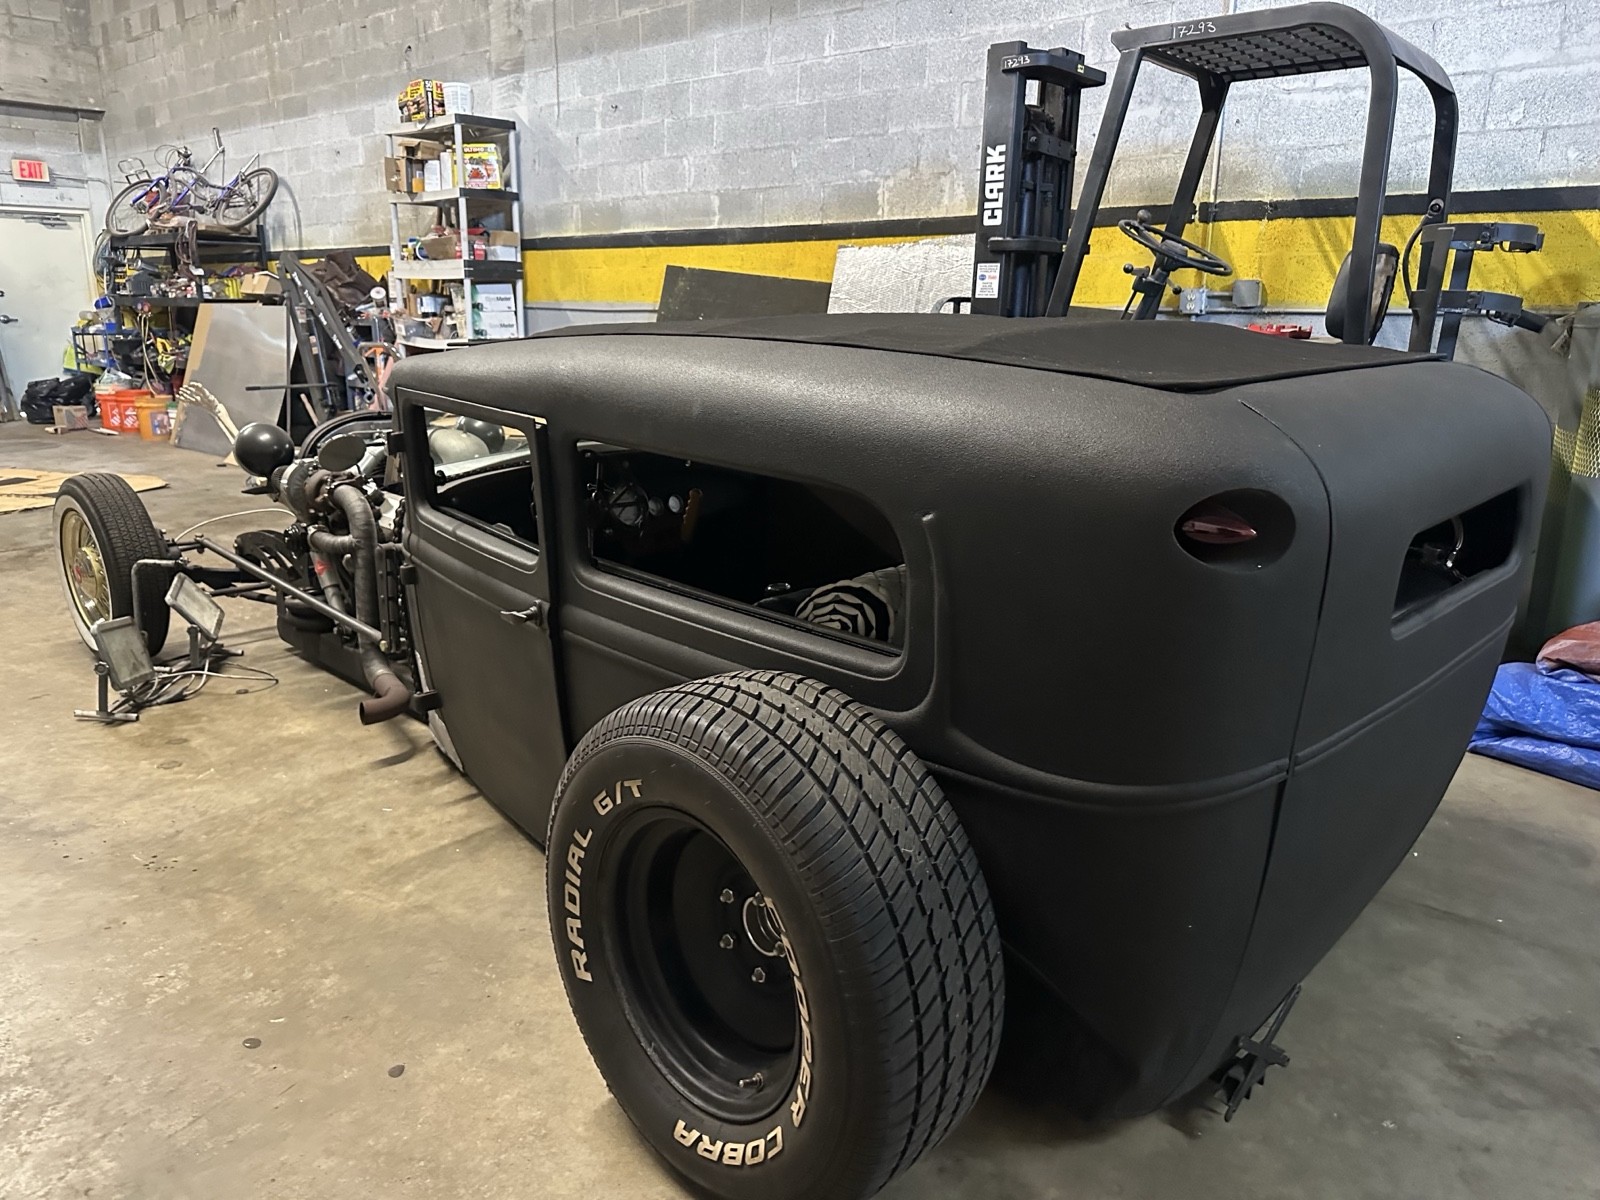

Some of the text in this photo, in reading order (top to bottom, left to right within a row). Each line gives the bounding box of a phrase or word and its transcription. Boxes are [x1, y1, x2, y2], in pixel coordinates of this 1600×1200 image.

[1172, 22, 1216, 39] 17293
[1004, 56, 1030, 68] 17293
[19, 161, 43, 180] EXIT
[983, 144, 1006, 226] CLARK
[565, 779, 643, 982] RADIAL G/T
[673, 1119, 784, 1166] COBRA
